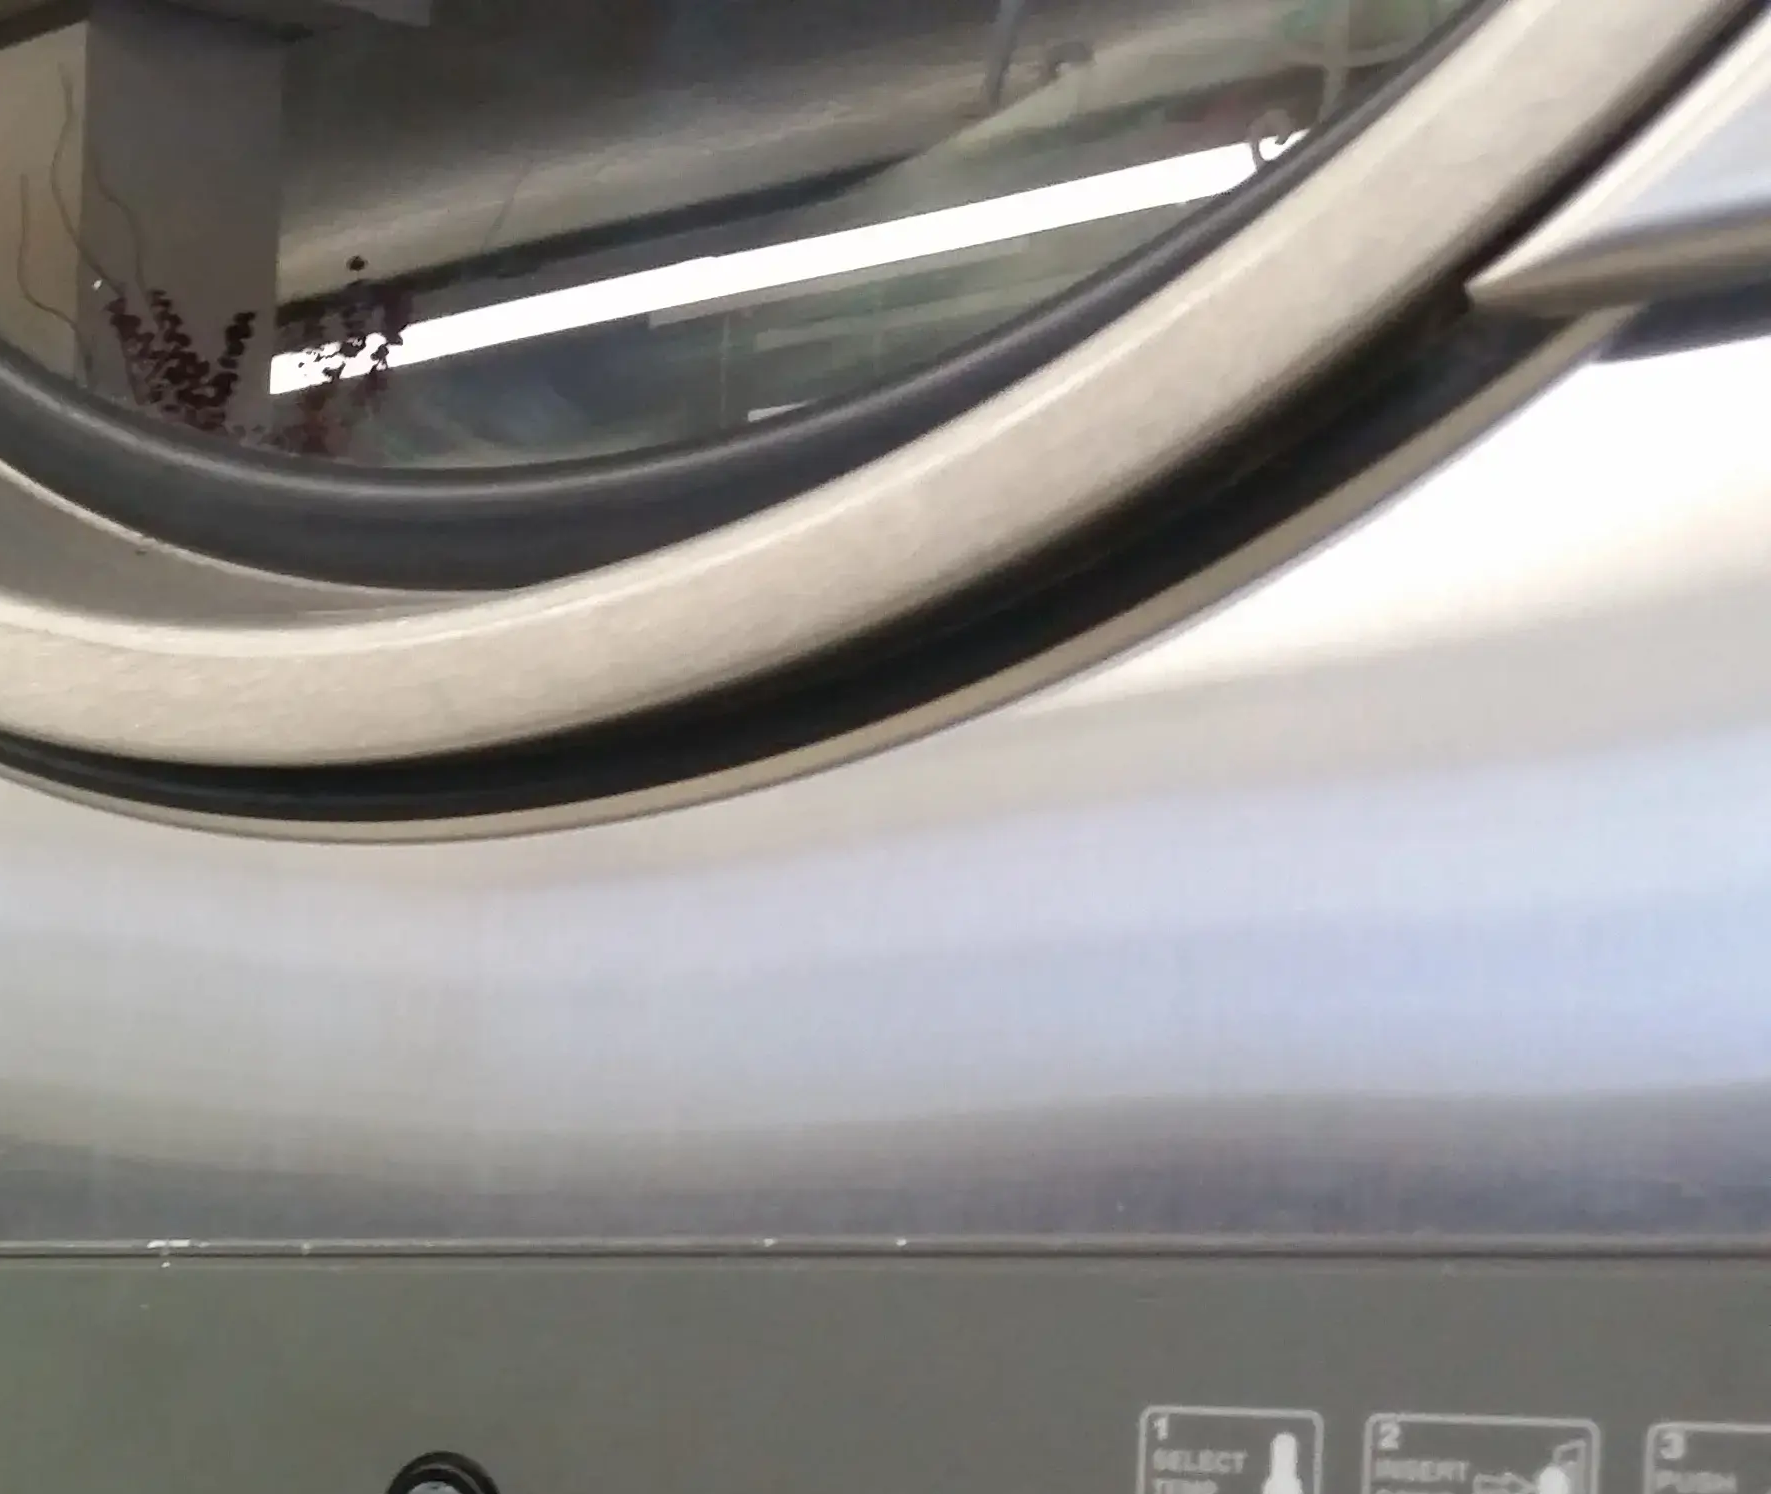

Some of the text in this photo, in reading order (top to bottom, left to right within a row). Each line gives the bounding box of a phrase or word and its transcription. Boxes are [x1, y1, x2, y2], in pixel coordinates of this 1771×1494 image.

[1153, 1417, 1169, 1441] 1
[1379, 1421, 1402, 1449] 2
[1659, 1432, 1685, 1461] 3
